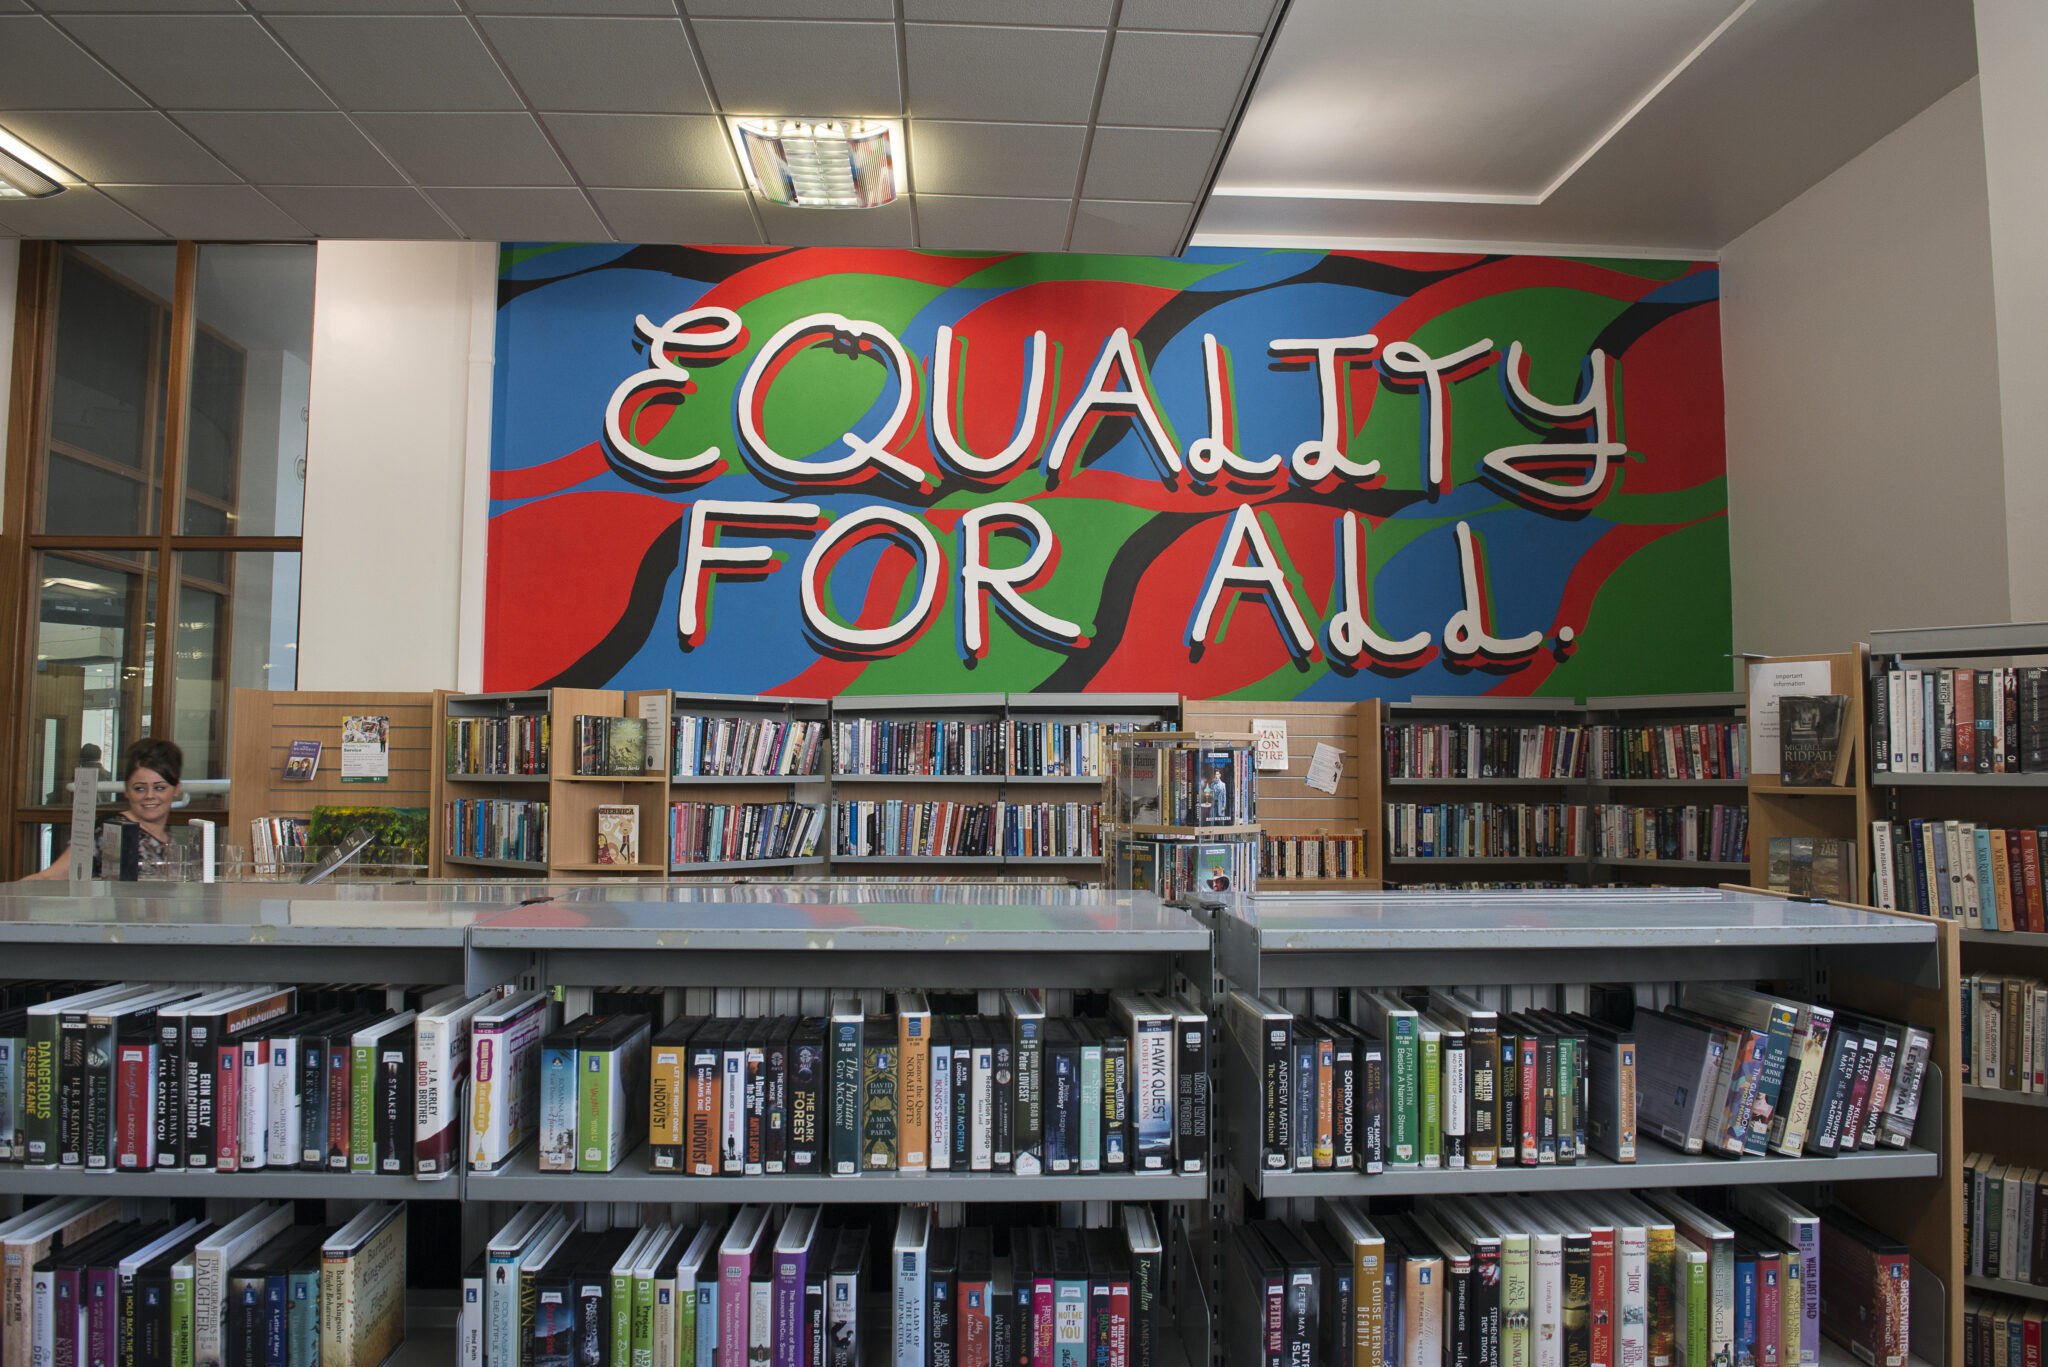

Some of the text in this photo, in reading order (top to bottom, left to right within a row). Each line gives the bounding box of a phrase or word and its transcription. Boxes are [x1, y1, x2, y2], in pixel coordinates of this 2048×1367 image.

[604, 305, 1628, 497] EQUALITY
[680, 500, 1081, 650] FOR
[1257, 730, 1284, 739] MAN
[1258, 751, 1284, 760] FIRE
[1262, 741, 1279, 749] ON
[1124, 768, 1154, 781] Strangers
[2024, 849, 2034, 863] NORA
[27, 1046, 36, 1114] JESSIE KEANE
[37, 1041, 51, 1119] DANGEROUS
[916, 1053, 924, 1083] Eleanor
[1018, 1052, 1028, 1102] Peter LOVESEY
[1152, 1038, 1165, 1121] HAWK QUEST
[1475, 1070, 1483, 1100] PROPHECY
[1839, 1054, 1848, 1072] MAY
[1844, 1051, 1856, 1079] PETER
[1857, 1056, 1866, 1075] MAY
[1862, 1052, 1873, 1082] PETER
[1879, 1054, 1887, 1074] MAY
[1884, 1051, 1896, 1080] PETER
[1894, 1047, 1918, 1116] LEWIS MAN
[1908, 1062, 1923, 1110] PETER MAY
[187, 1062, 197, 1138] BROADCHURCH
[200, 1074, 210, 1126] ERIN KELLY
[388, 1078, 396, 1120] STALKER
[418, 1062, 427, 1124] BLOOD BROTHER
[429, 1087, 437, 1116] KERLEY
[653, 1078, 666, 1129] LINDQVIST
[845, 1058, 858, 1130] The Puritans
[906, 1056, 914, 1124] NORAH LOFTS
[1057, 1077, 1065, 1109] Lovesey
[1105, 1058, 1115, 1119] MALCOLM LOWRY
[1181, 1074, 1191, 1135] ICE FORCE
[1194, 1072, 1205, 1136] MATT LYNN
[1279, 1060, 1287, 1145] ANDREW MARTIN
[1344, 1070, 1352, 1153] SORROW BOUND
[1740, 1067, 1760, 1133] The GLASS ROOM
[1867, 1083, 1885, 1135] RUNAWAY
[693, 1114, 707, 1164] LINDQVIST
[794, 1092, 804, 1142] FOREST
[806, 1092, 814, 1142] THE DARK
[1844, 1104, 1854, 1128] ROOM
[198, 1258, 210, 1332] DAUGHTER
[325, 1270, 333, 1290] Flight
[1136, 1259, 1152, 1311] Rapscallion
[1372, 1281, 1381, 1320] LOUISE
[336, 1270, 344, 1344] Barbara Kingsolver
[995, 1314, 1003, 1330] IAN
[1112, 1314, 1118, 1323] TO
[1270, 1297, 1281, 1350] PETER MAY
[1357, 1307, 1369, 1346] BEAUTY
[1899, 1280, 1909, 1357] GHOSTWRITTEN
[1111, 1340, 1118, 1348] IN
[1117, 1324, 1125, 1353] MILLION
[1480, 1337, 1488, 1363] moon
